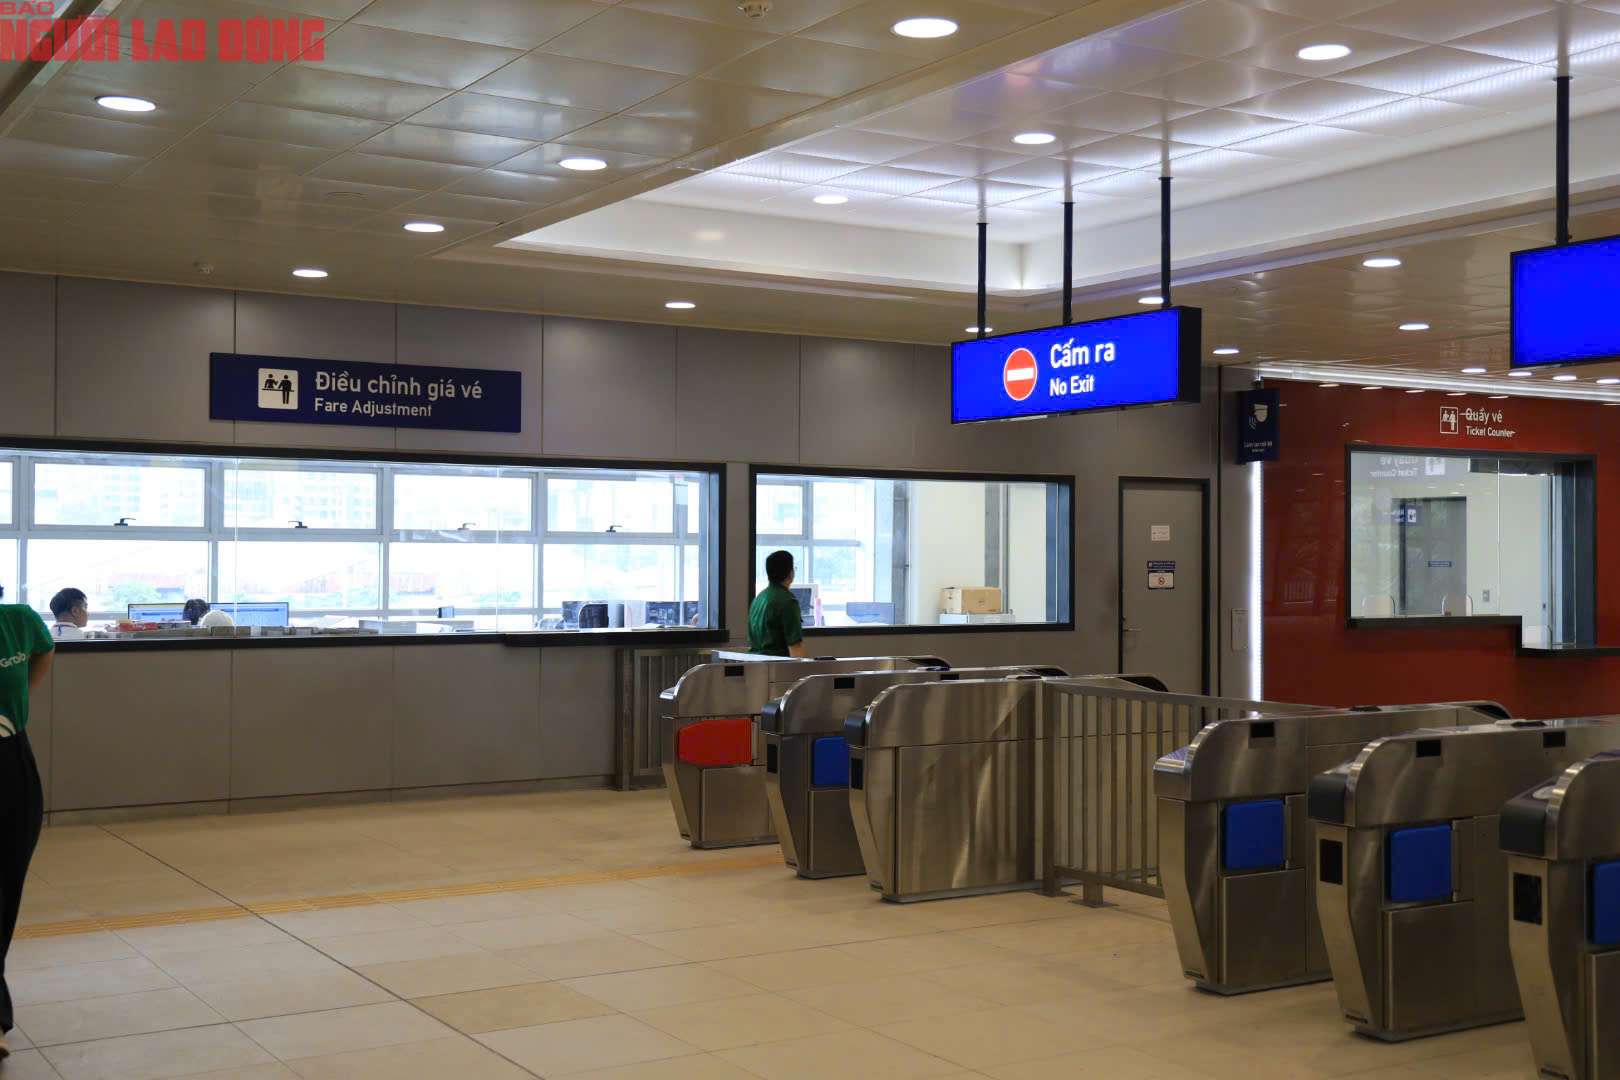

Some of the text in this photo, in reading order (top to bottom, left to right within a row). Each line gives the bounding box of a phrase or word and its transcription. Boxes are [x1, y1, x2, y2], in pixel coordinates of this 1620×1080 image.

[1050, 338, 1115, 368] Cấm ra
[315, 371, 482, 401] Điều chỉnh giá vé
[1050, 375, 1095, 396] No Exit
[314, 397, 433, 417] Fare Adjustment
[1465, 407, 1503, 424] Quầy vé
[1465, 425, 1513, 437] Ticket Counter
[0, 651, 27, 668] Grab
